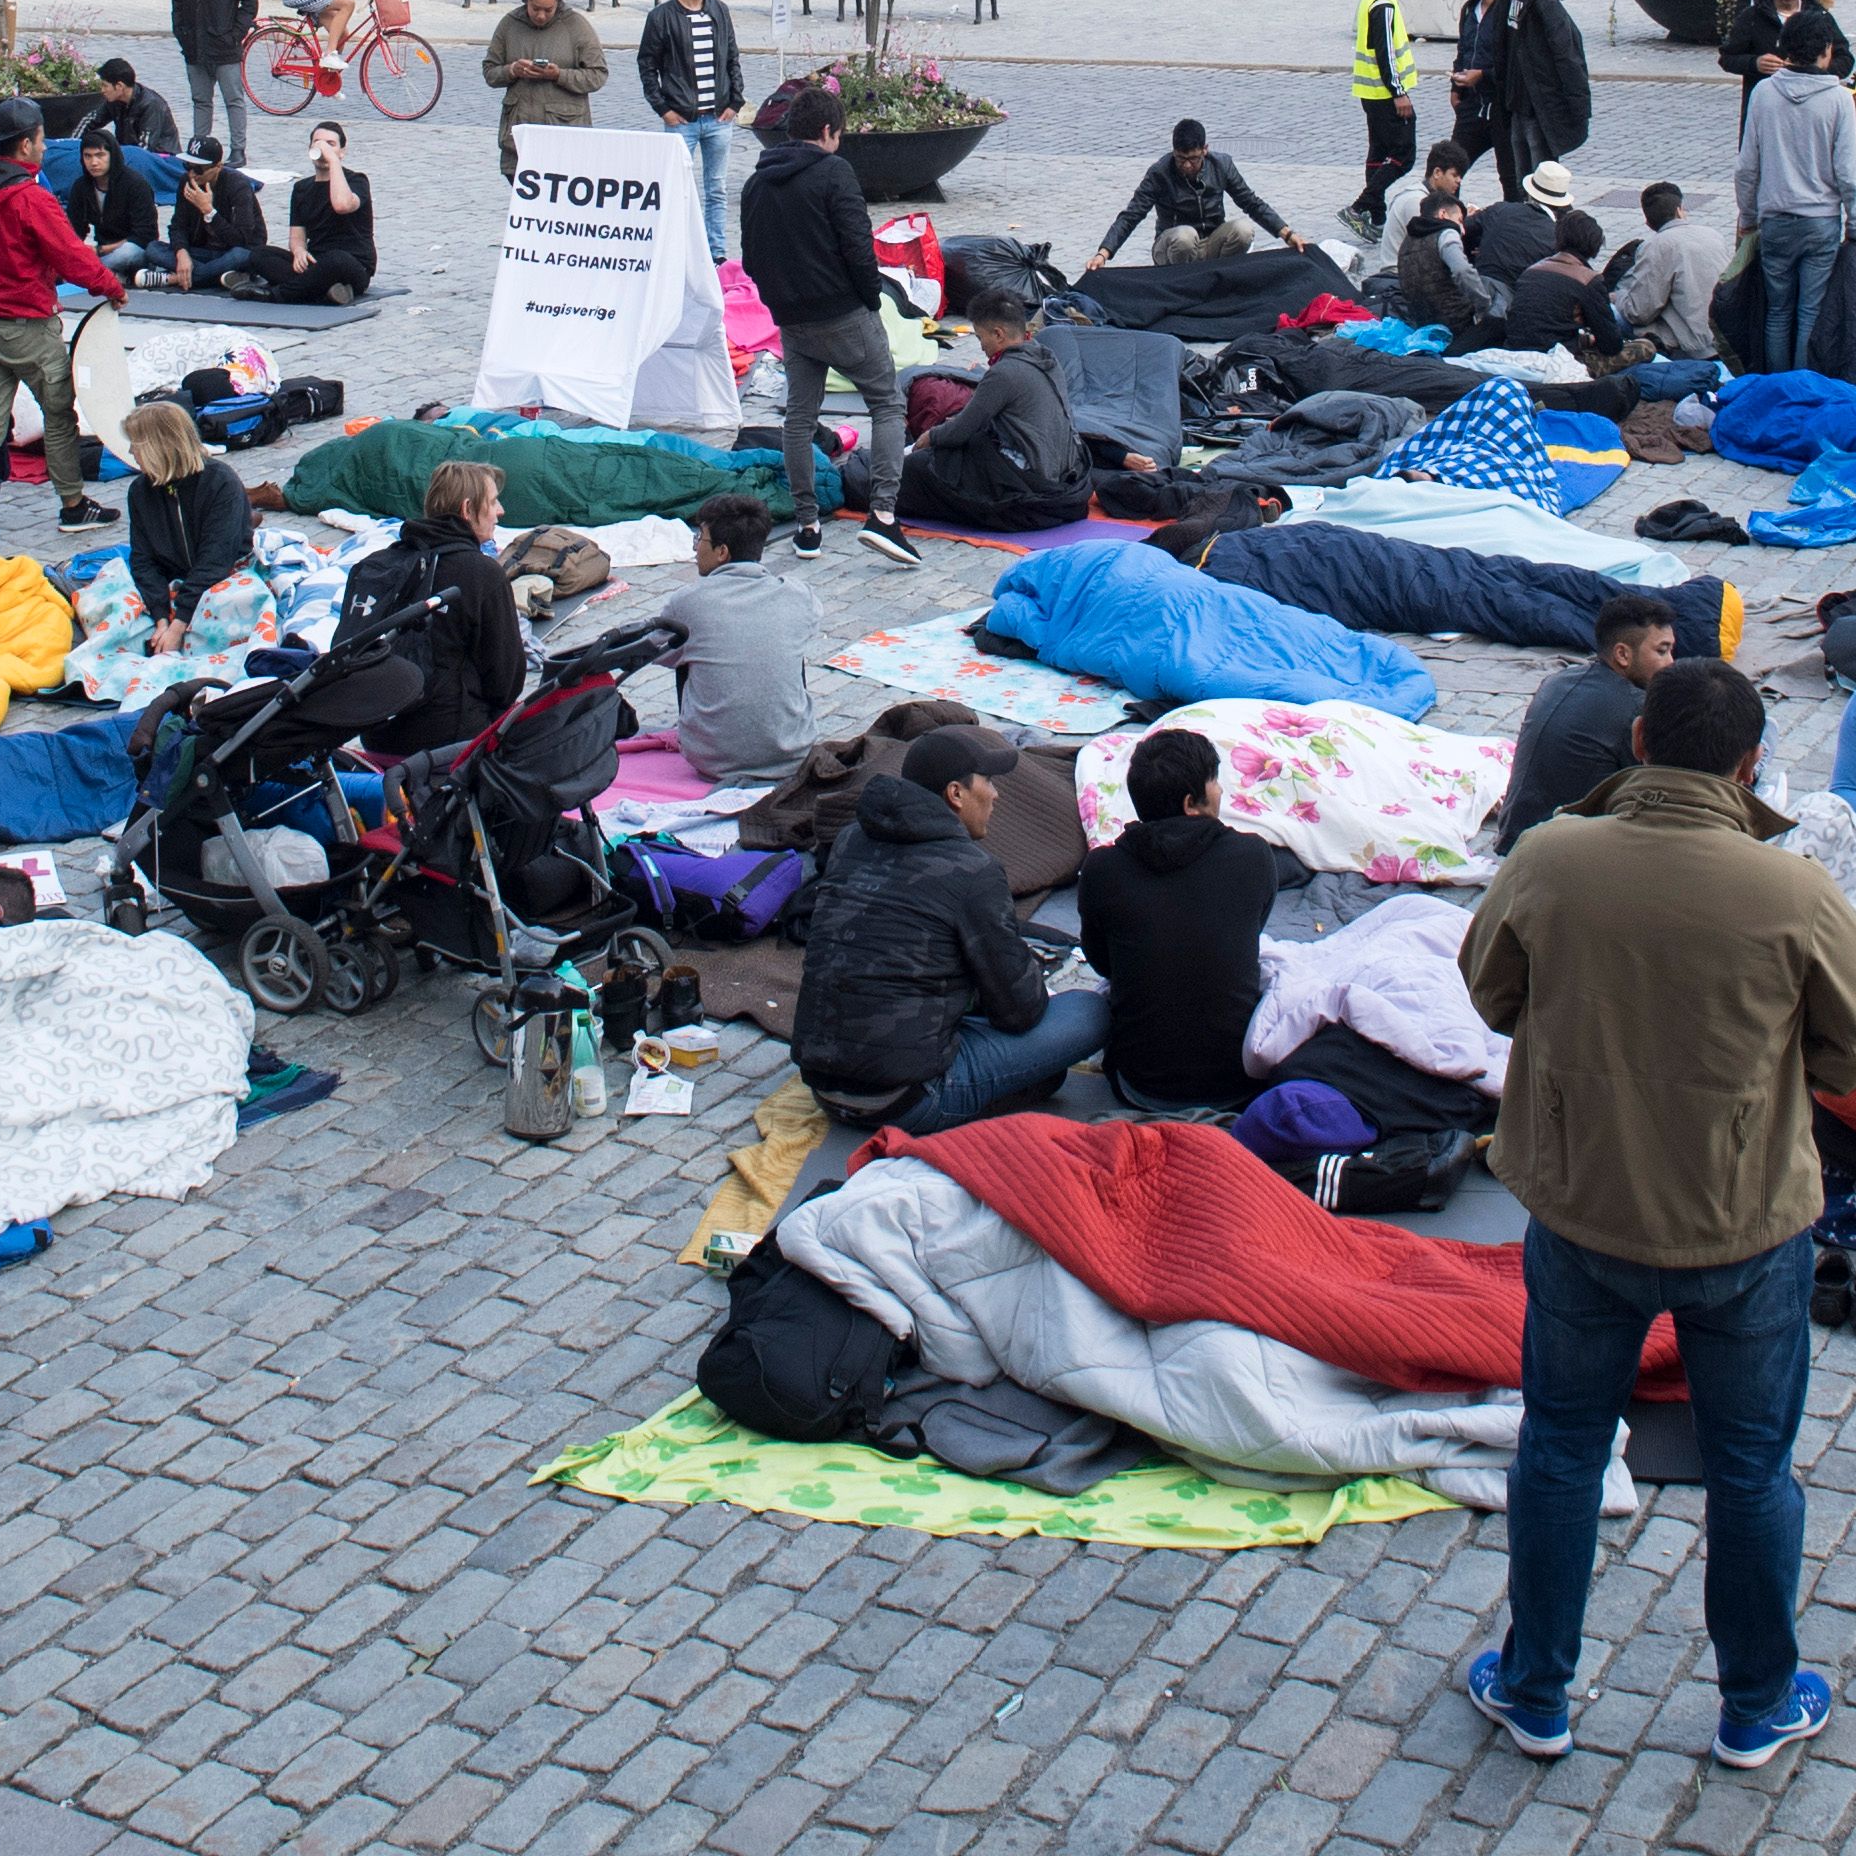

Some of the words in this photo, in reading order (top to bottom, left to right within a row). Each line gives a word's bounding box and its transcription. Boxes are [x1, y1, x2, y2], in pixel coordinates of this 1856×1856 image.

[515, 169, 662, 211] STOPPA
[509, 214, 654, 242] UTVISNINGARNA
[502, 245, 540, 264] TILL
[544, 251, 652, 273] AFGHANISTAN
[525, 299, 617, 321] #ungisverige
